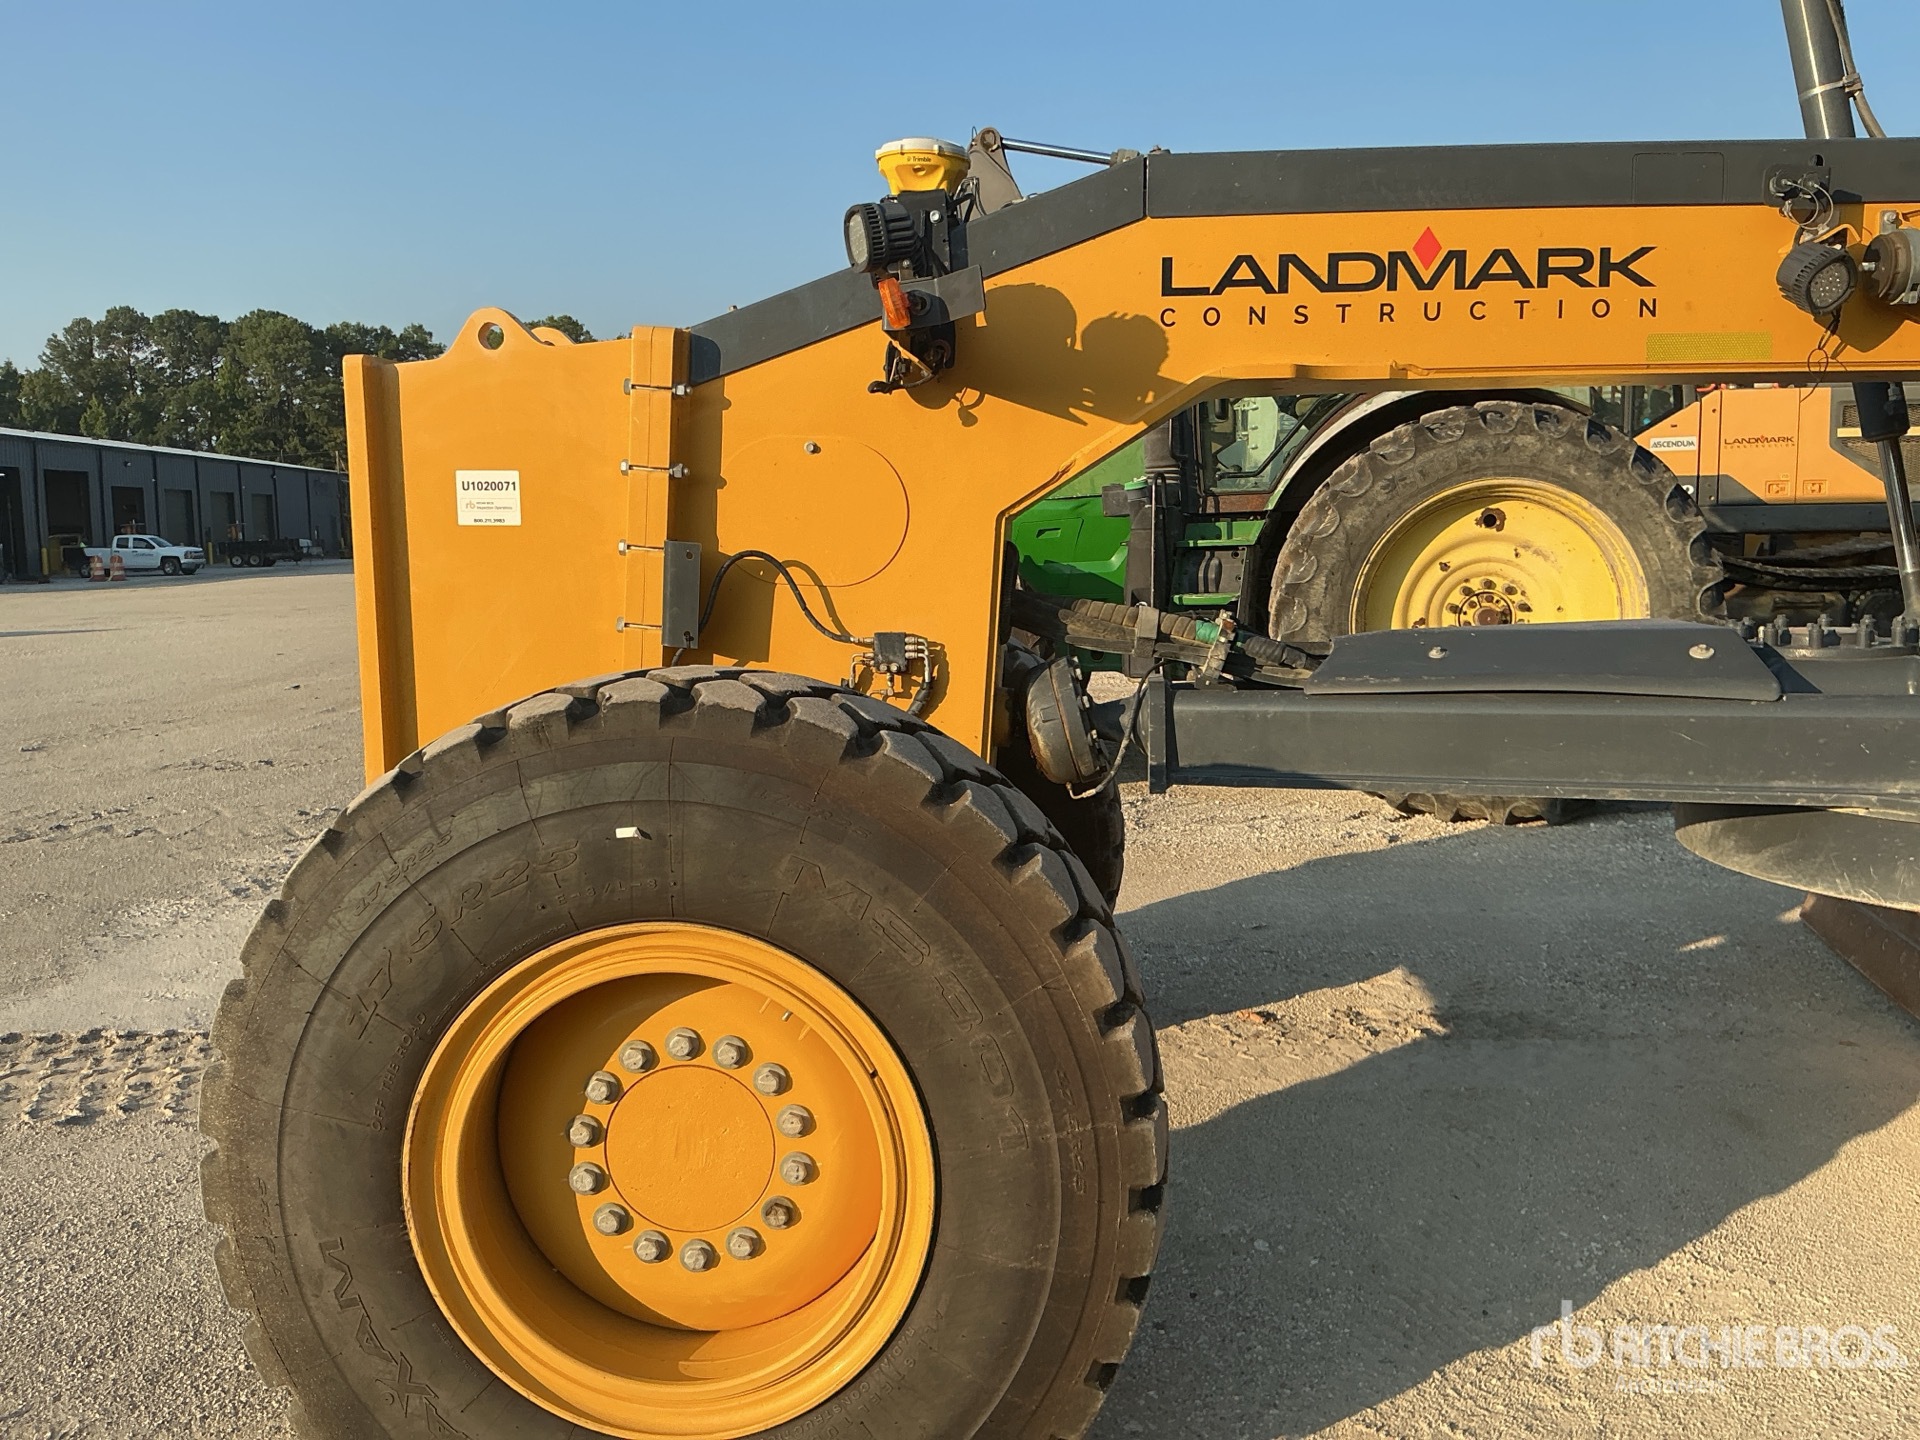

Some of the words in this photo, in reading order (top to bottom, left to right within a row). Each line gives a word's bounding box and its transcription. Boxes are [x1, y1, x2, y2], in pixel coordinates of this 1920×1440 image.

[1161, 246, 1658, 297] LANDMARK
[1160, 298, 1657, 328] CONSTRUCTION
[1651, 440, 1696, 449] ASCENDUM
[1724, 436, 1795, 445] LANDMARK
[461, 480, 516, 491] U1020071
[346, 839, 581, 1040] 17.5R25
[378, 1060, 401, 1094] THE
[393, 1009, 428, 1058] ROAD
